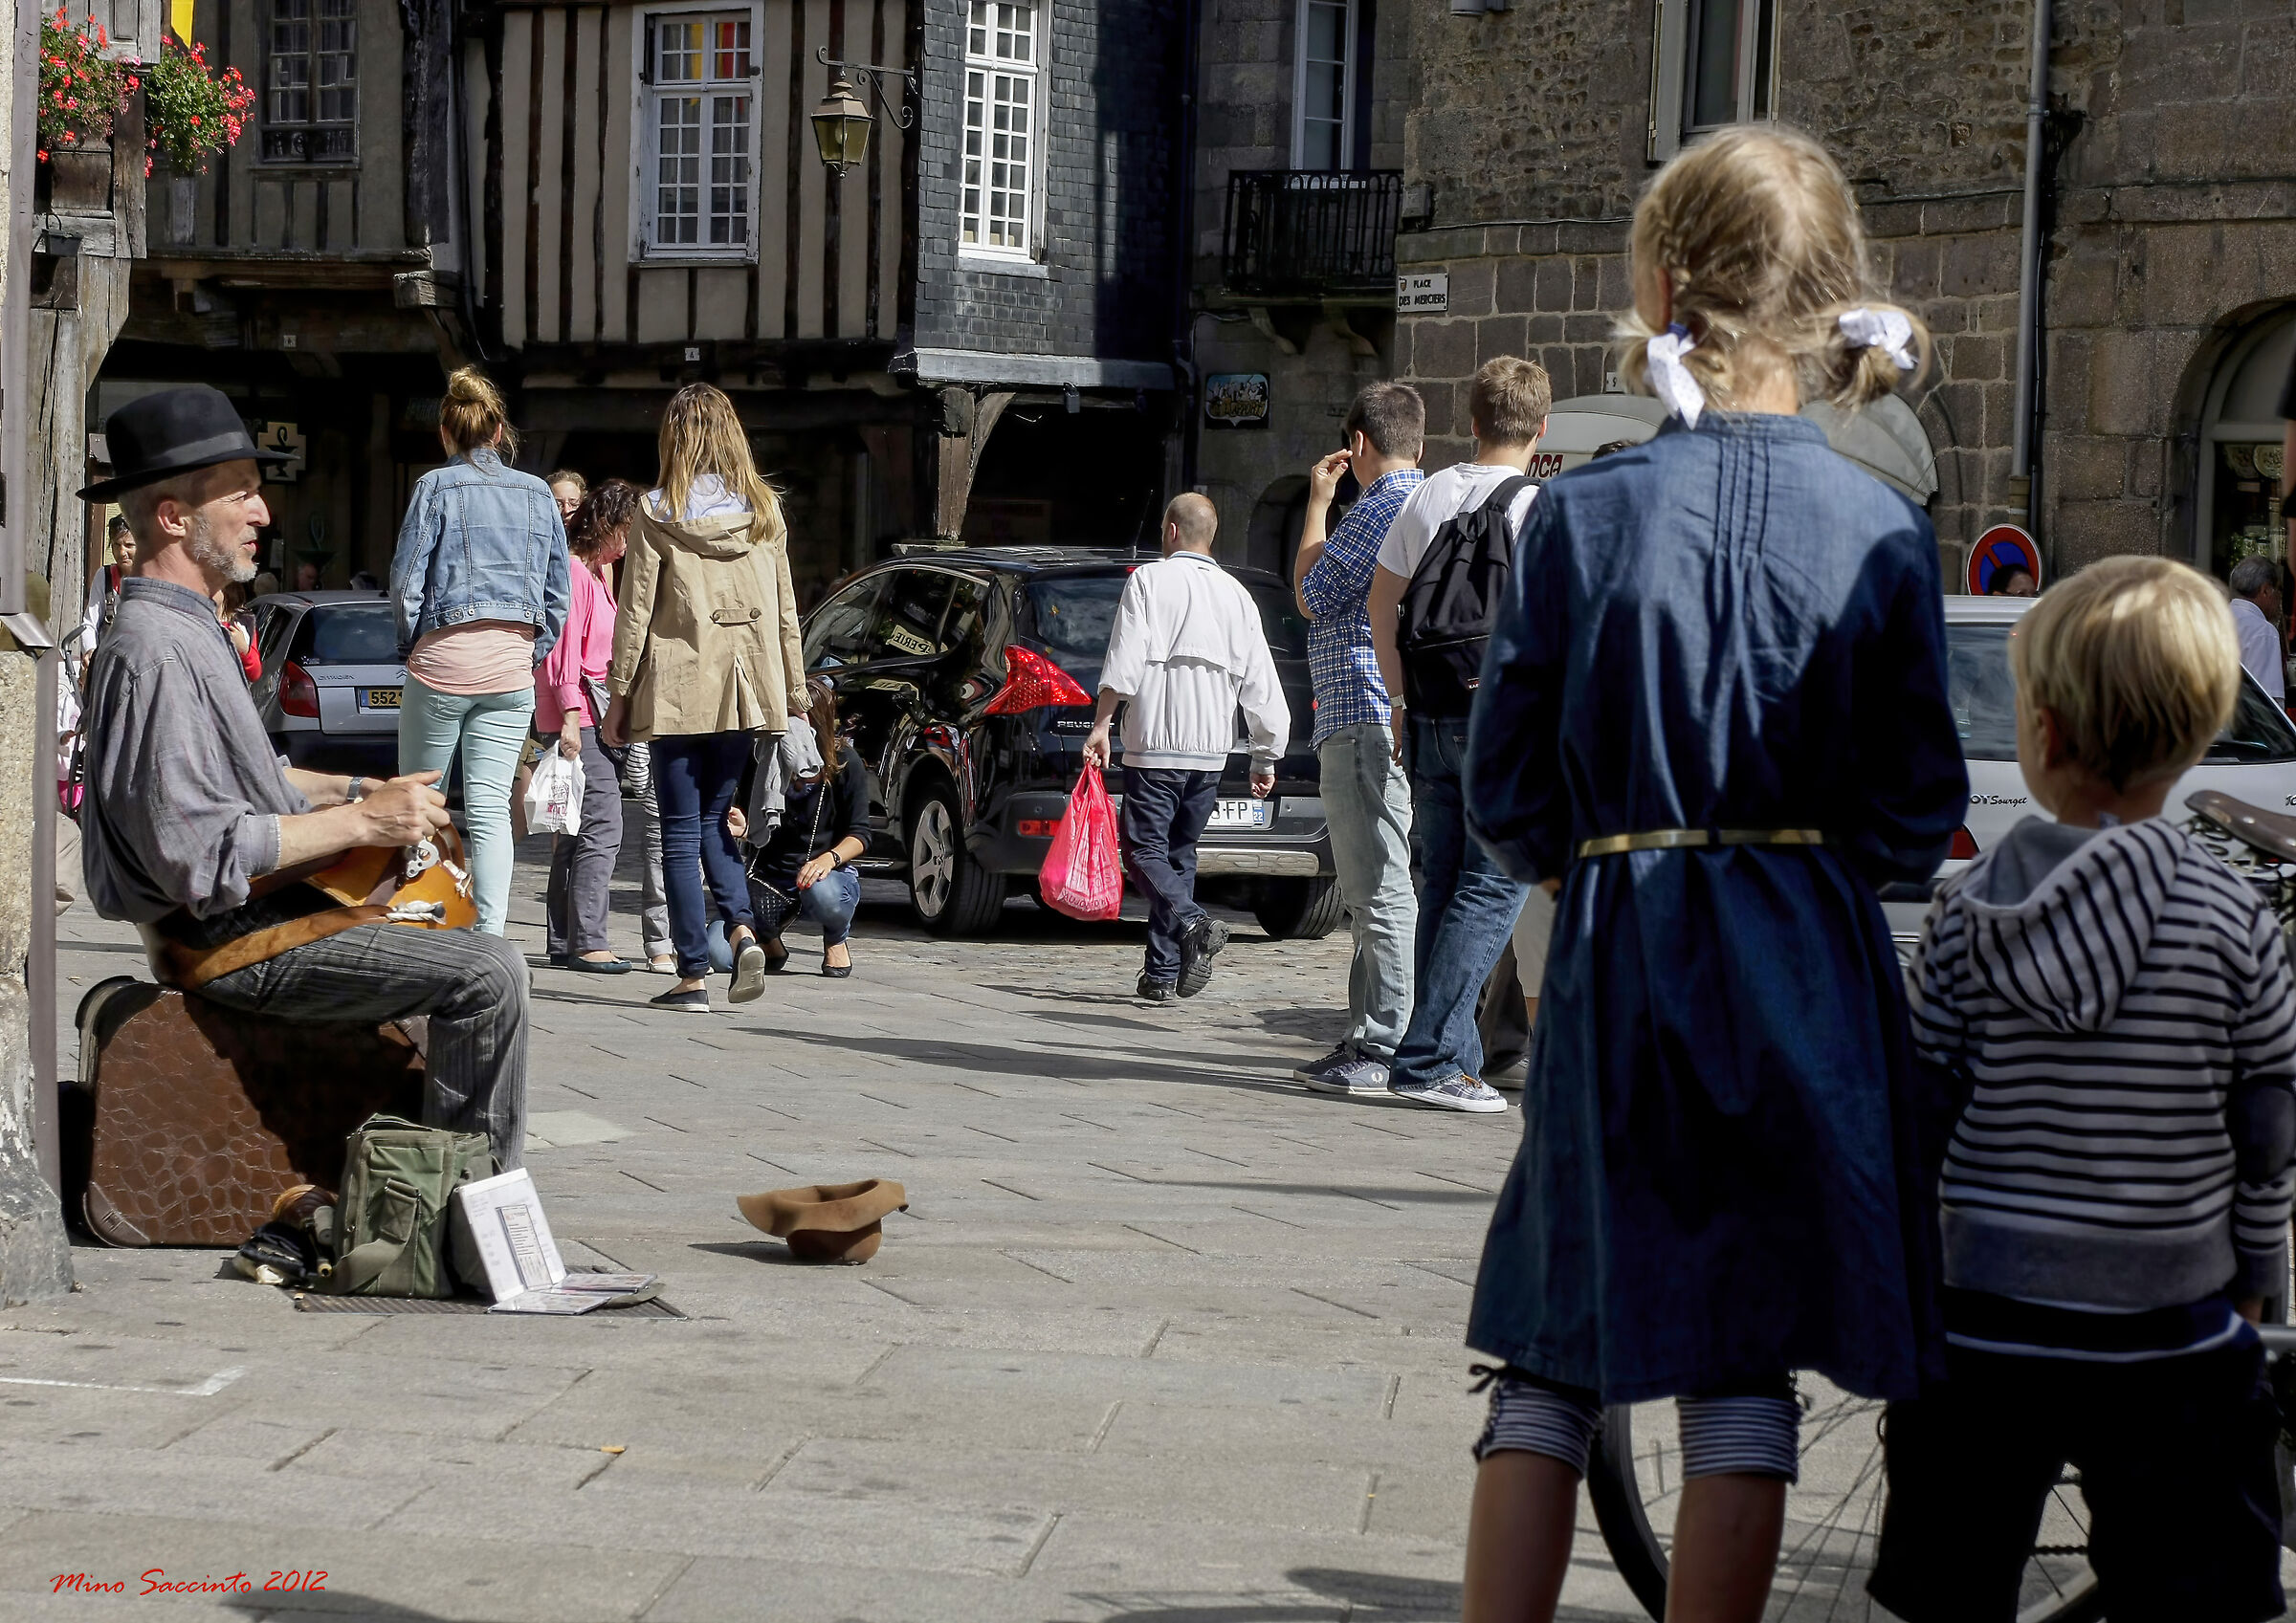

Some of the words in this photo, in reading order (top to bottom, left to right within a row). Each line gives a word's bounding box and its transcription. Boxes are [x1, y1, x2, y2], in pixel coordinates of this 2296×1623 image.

[1413, 279, 1431, 288] PLACE
[1399, 296, 1410, 306] DES
[1414, 294, 1446, 305] MERCIERS
[371, 691, 398, 705] 552
